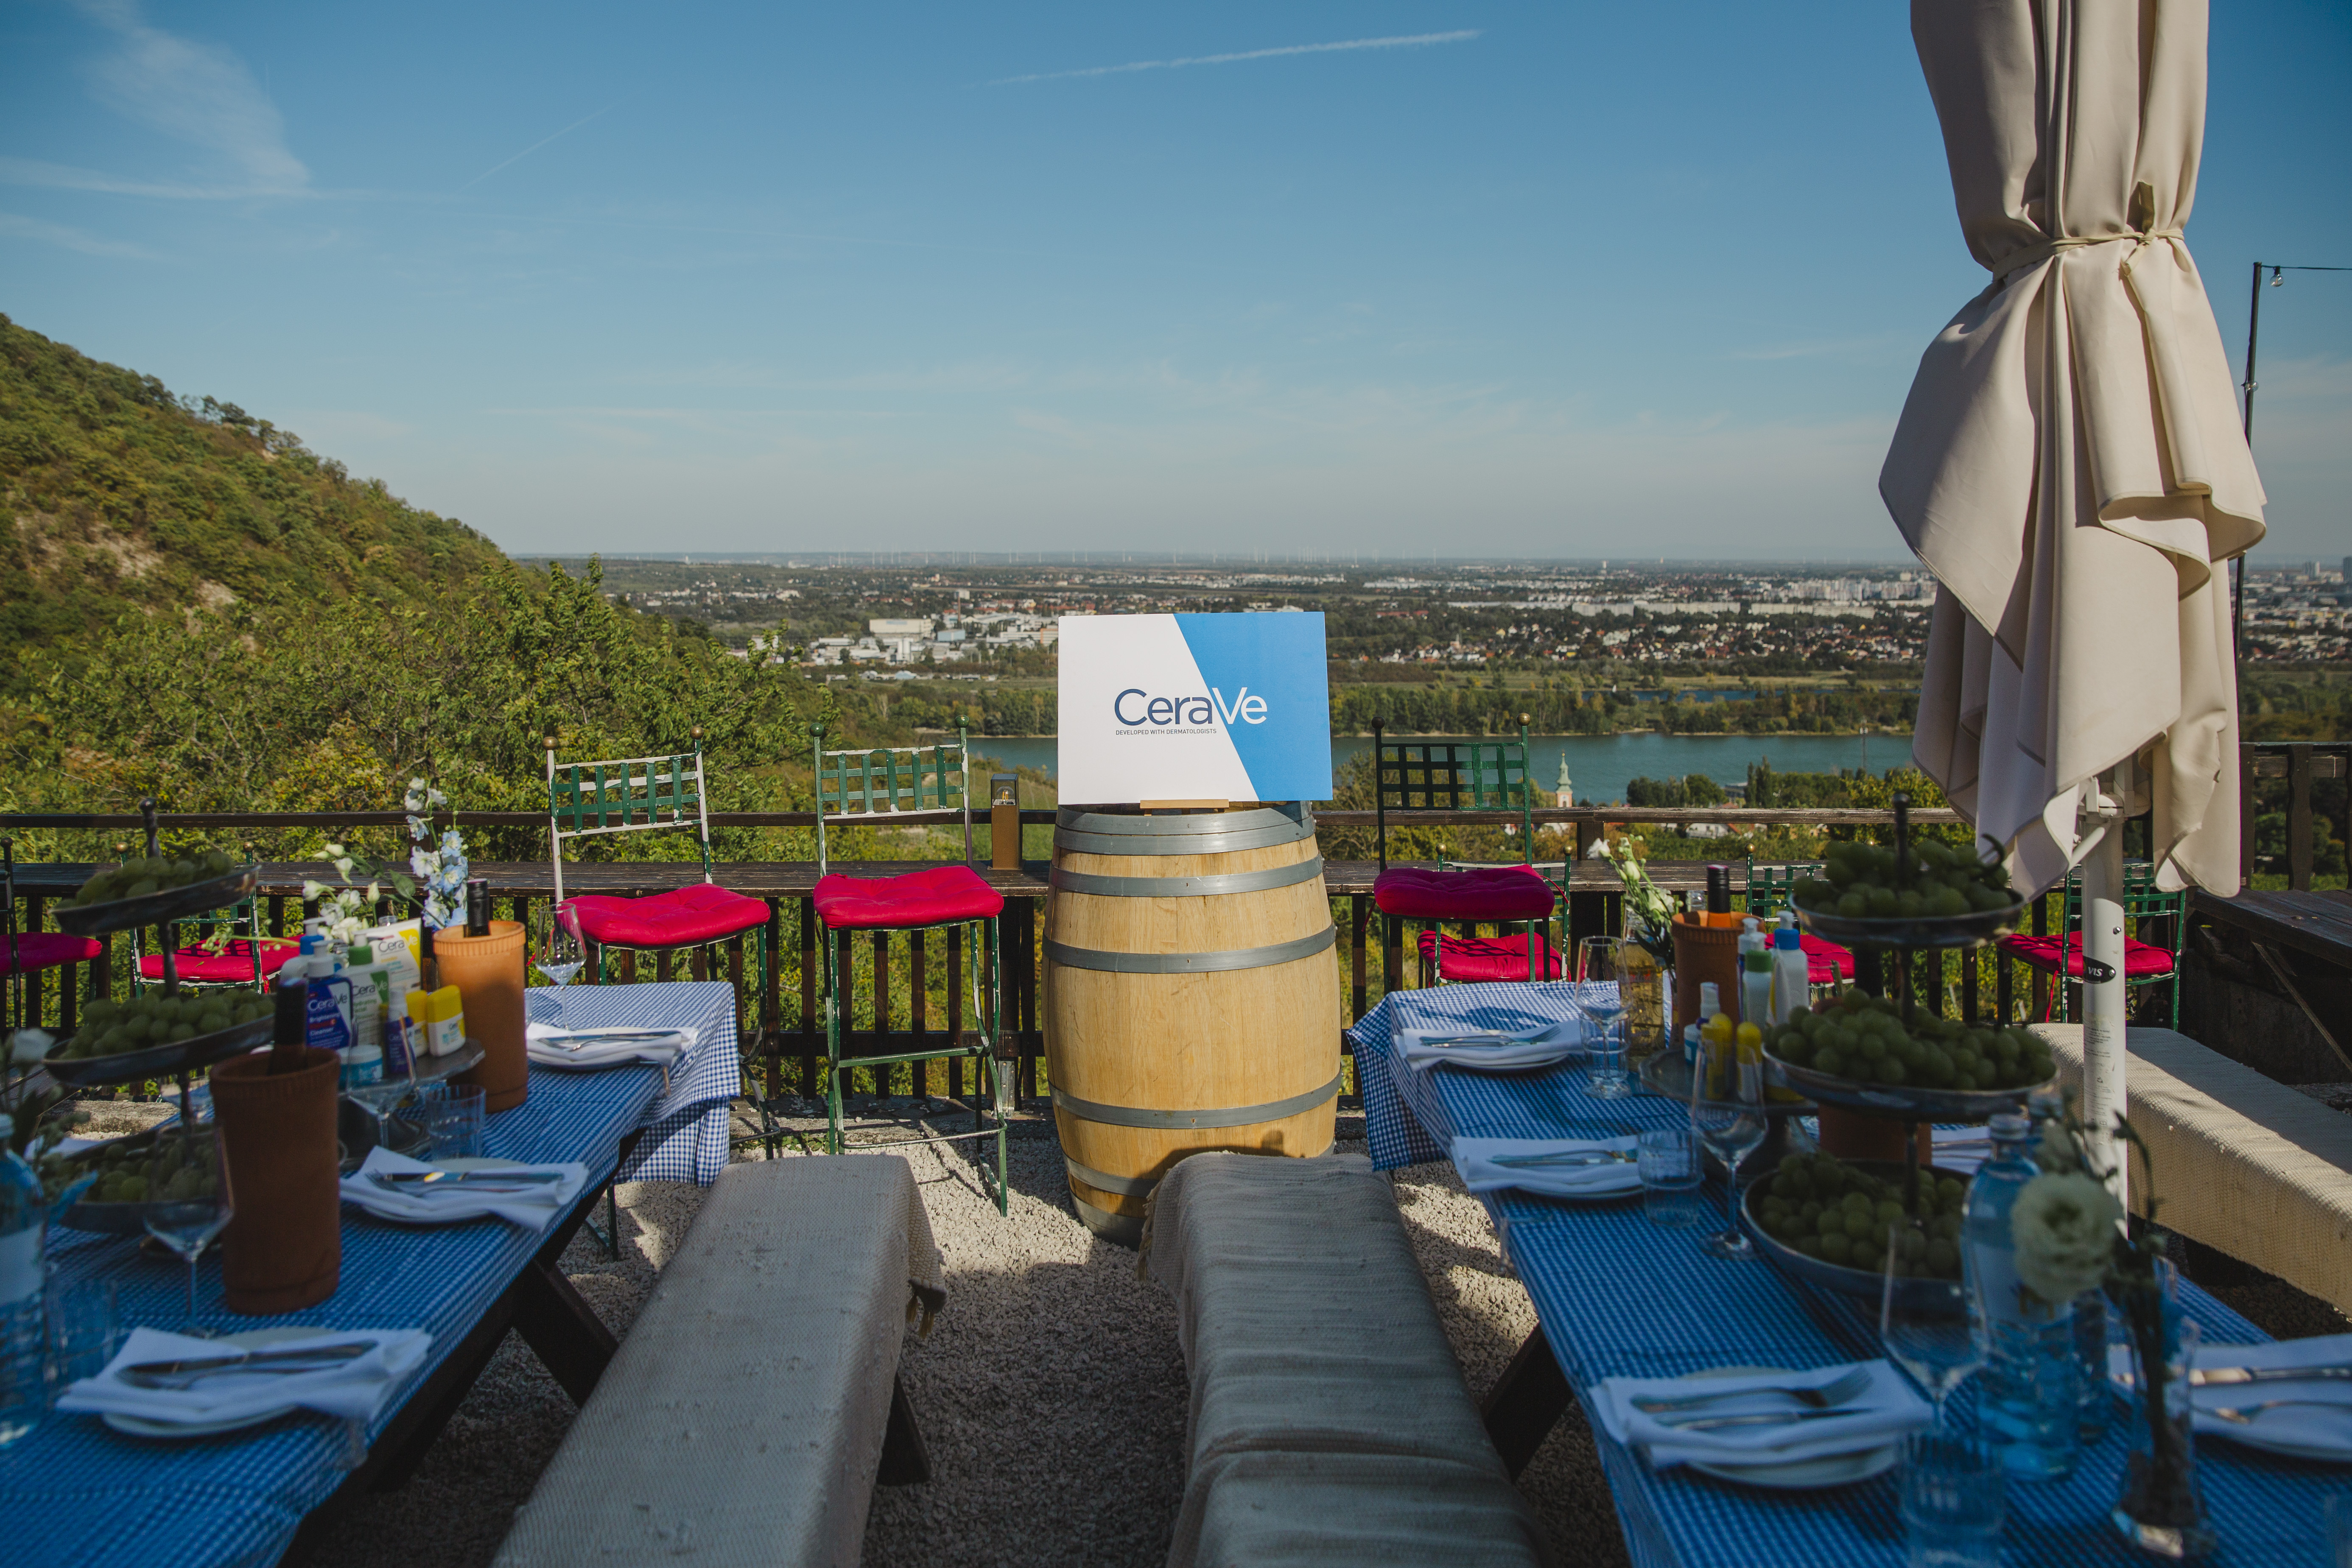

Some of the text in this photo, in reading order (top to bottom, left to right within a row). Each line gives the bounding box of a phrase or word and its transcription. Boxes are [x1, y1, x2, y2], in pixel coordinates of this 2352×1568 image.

[1114, 687, 1268, 726] CeraVe
[379, 934, 418, 953] CeraVe
[309, 993, 347, 1011] CeraVe
